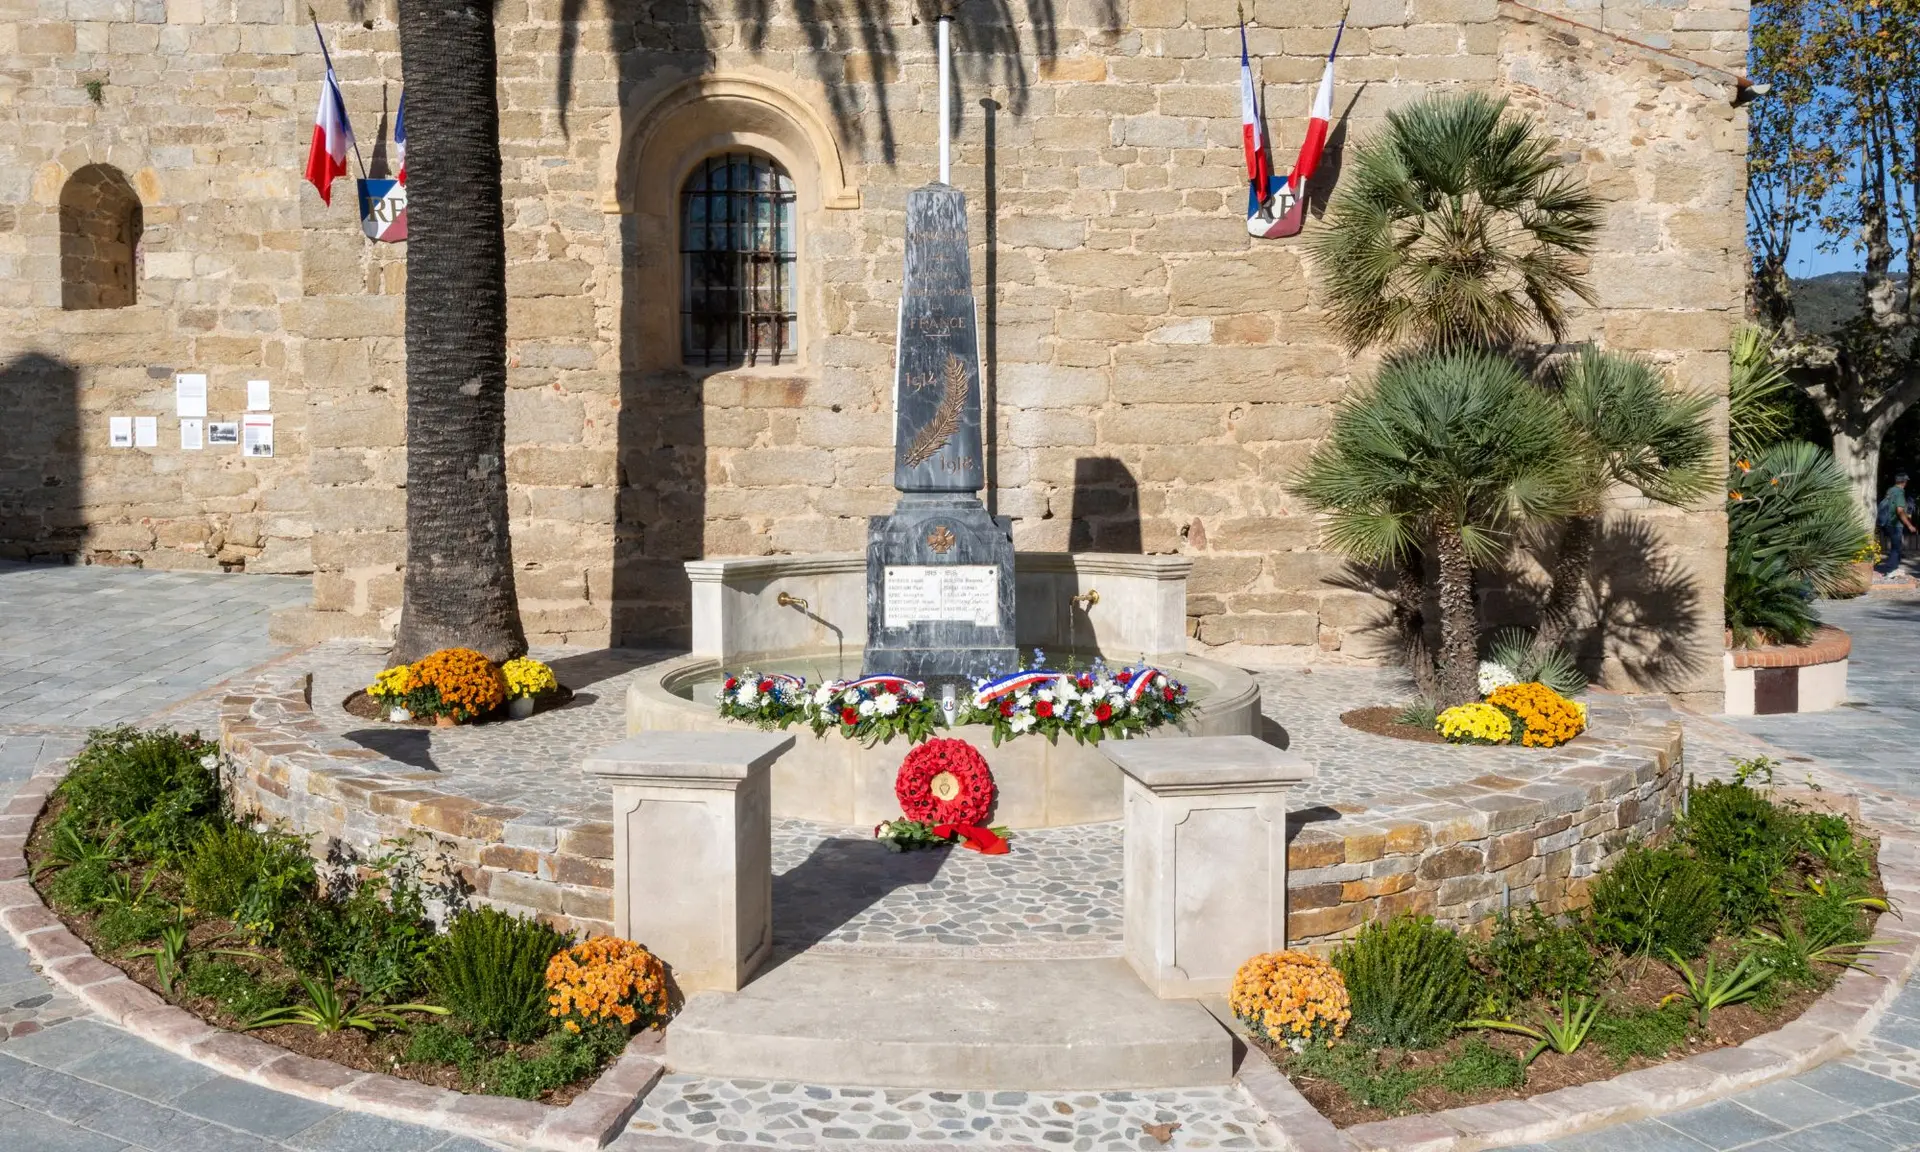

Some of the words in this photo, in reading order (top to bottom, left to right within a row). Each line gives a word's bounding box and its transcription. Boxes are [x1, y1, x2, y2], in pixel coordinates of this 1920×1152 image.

[366, 196, 404, 223] RF
[1255, 194, 1296, 220] RF
[909, 317, 966, 329] FRANCE
[905, 371, 937, 388] 1914
[941, 455, 973, 474] 1918
